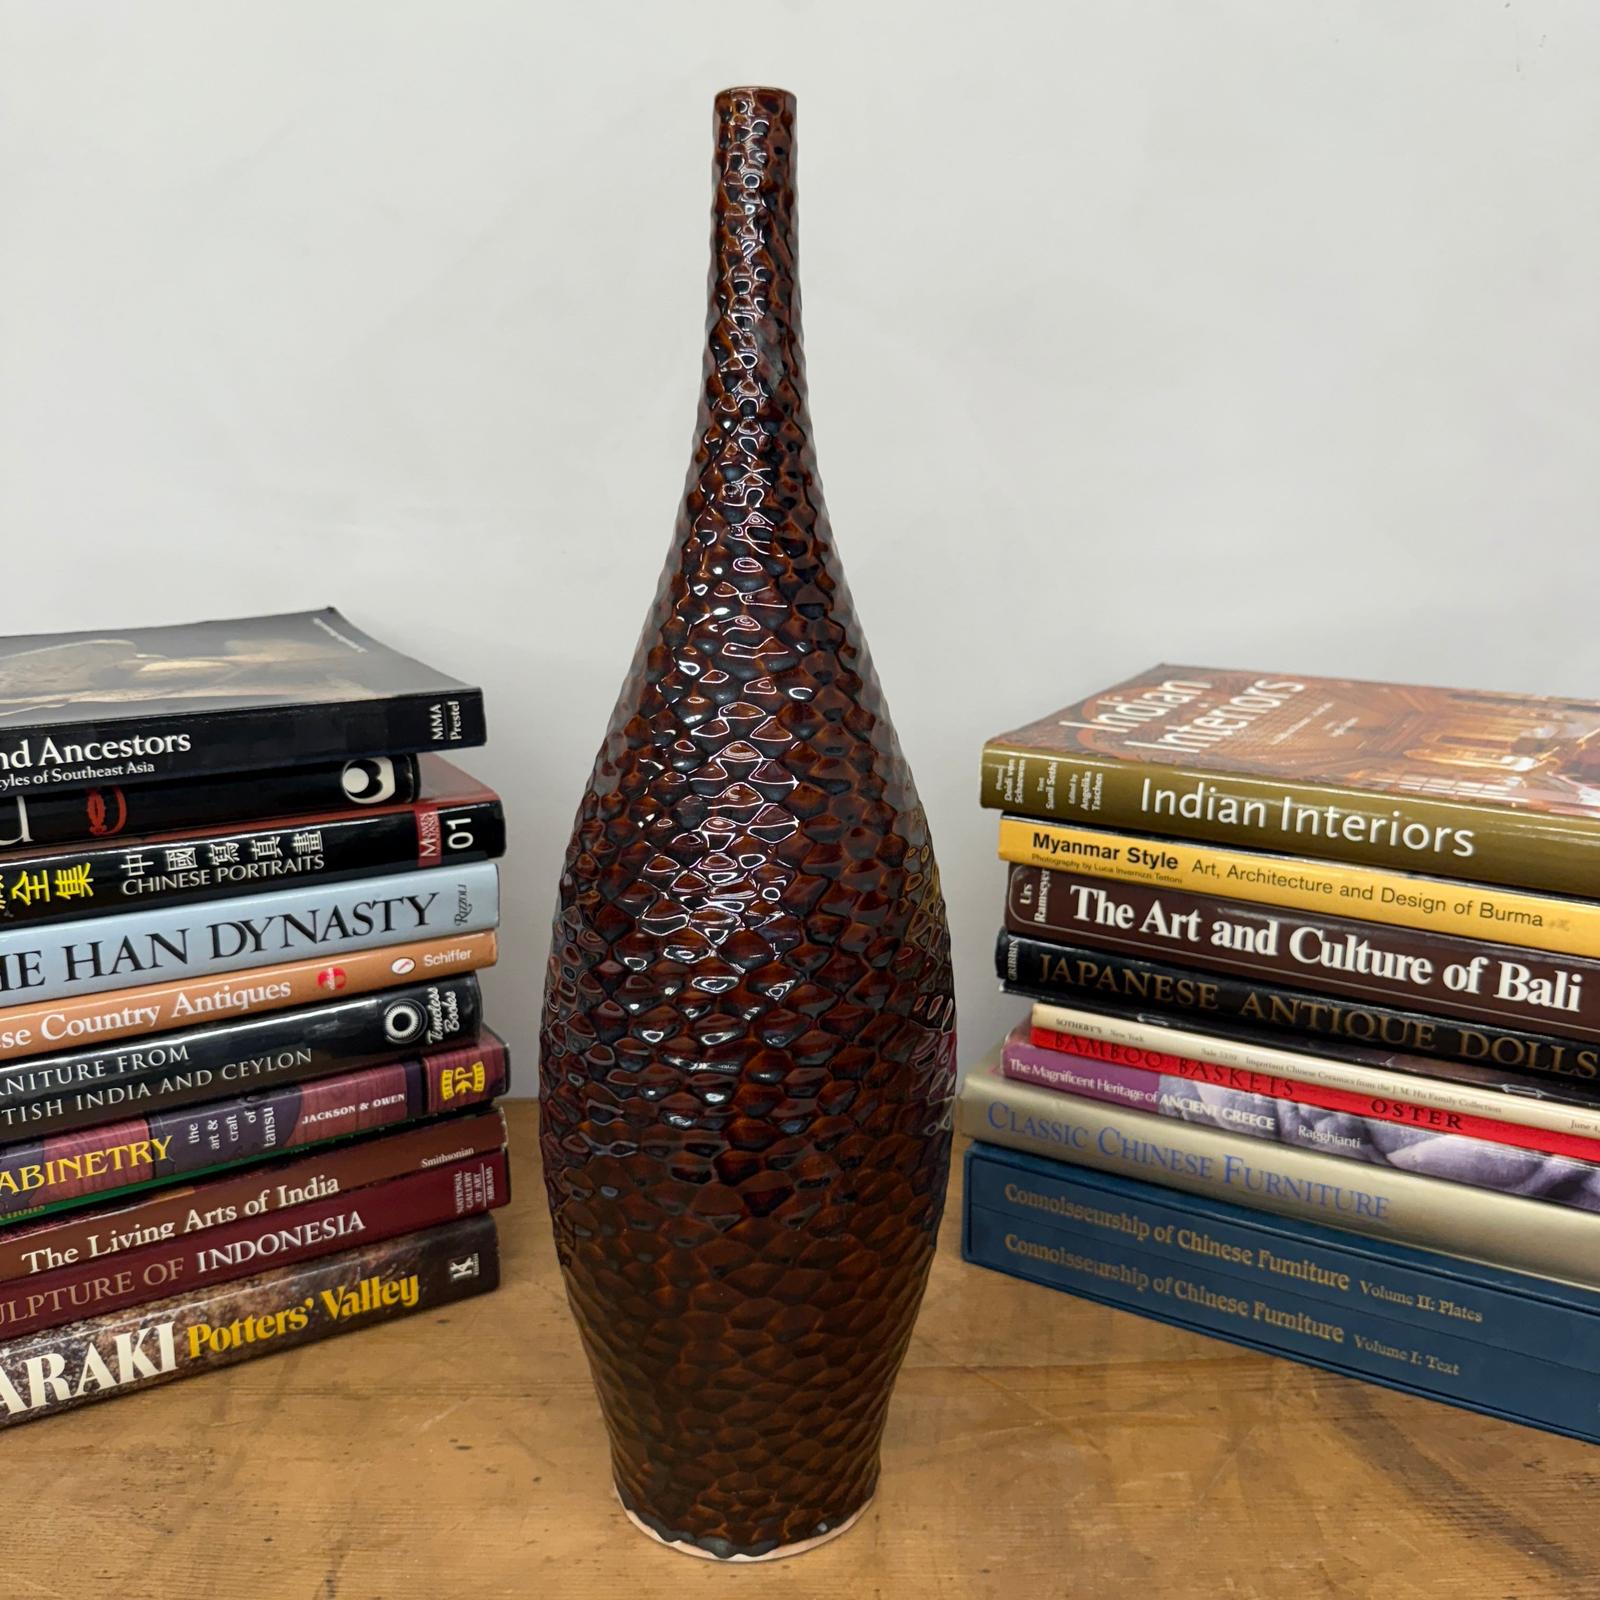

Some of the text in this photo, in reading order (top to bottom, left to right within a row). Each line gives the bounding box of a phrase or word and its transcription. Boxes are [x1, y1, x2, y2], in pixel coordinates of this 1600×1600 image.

[429, 703, 444, 740] MMA
[447, 700, 463, 740] Prestel
[1058, 679, 1213, 734] Indian
[1123, 679, 1306, 754] Interiors
[38, 733, 192, 767] Ancestors
[33, 770, 48, 784] of
[51, 764, 123, 783] Southeast
[126, 761, 155, 774] Asia
[446, 817, 474, 849] 01
[1140, 777, 1476, 858] Indian Interiors
[121, 854, 325, 896] CHINESE PORTRAITS
[1032, 852, 1080, 870] Photography
[1082, 861, 1093, 871] by
[1094, 863, 1114, 874] Luca
[1032, 831, 1544, 928] Myanmar Style Art, Architecture and Design of Burma
[0, 863, 94, 909] 全集
[1019, 883, 1034, 906] Urs
[1033, 867, 1051, 924] Ramseyer
[61, 928, 190, 983] HAN
[207, 892, 440, 960] DYNASTY
[423, 949, 473, 967] Schiffer
[1070, 884, 1585, 1013] The Art and Culture of Bali
[0, 979, 292, 1049] se Country Antiques
[426, 986, 444, 1045] Timeless
[441, 990, 460, 1033] Books
[1039, 953, 1600, 1080] JAPANESE ANTIQUE DOLLS
[76, 1081, 152, 1112] INDIA
[159, 1069, 213, 1095] AND
[221, 1047, 313, 1081] CEYLON
[116, 1044, 191, 1074] FROM
[1053, 1031, 1464, 1131] BAMBOO BASKETS OSTER
[243, 1110, 257, 1123] of
[301, 1092, 406, 1126] JACKSON & OWEN
[1009, 1057, 1277, 1132] The Magnificent Heritage of ANCIENT GREECE
[188, 1122, 200, 1145] the
[207, 1119, 221, 1151] art &
[225, 1114, 239, 1142] craft
[263, 1106, 277, 1148] tansu
[1298, 1123, 1361, 1150] Ragghianti
[420, 1146, 475, 1169] Smithsonian
[21, 1174, 340, 1275] The Living Arts of India
[143, 1256, 185, 1287] OF
[197, 1210, 367, 1275] INDONESIA
[1004, 1182, 1150, 1241] Connoisseurship
[1153, 1224, 1175, 1243] of
[1177, 1228, 1254, 1265] Chinese
[1257, 1247, 1350, 1291] Furniture
[1359, 1279, 1414, 1306] Volume
[1439, 1299, 1483, 1324] Plates
[187, 1297, 315, 1360] Potters'
[320, 1274, 420, 1321] Valley
[1004, 1233, 1149, 1292] Connoisseurship
[1153, 1275, 1174, 1294] of
[1175, 1279, 1250, 1317] Chinese
[1252, 1301, 1345, 1344] Furniture
[1353, 1333, 1407, 1362] Volume
[1426, 1354, 1460, 1376] Text
